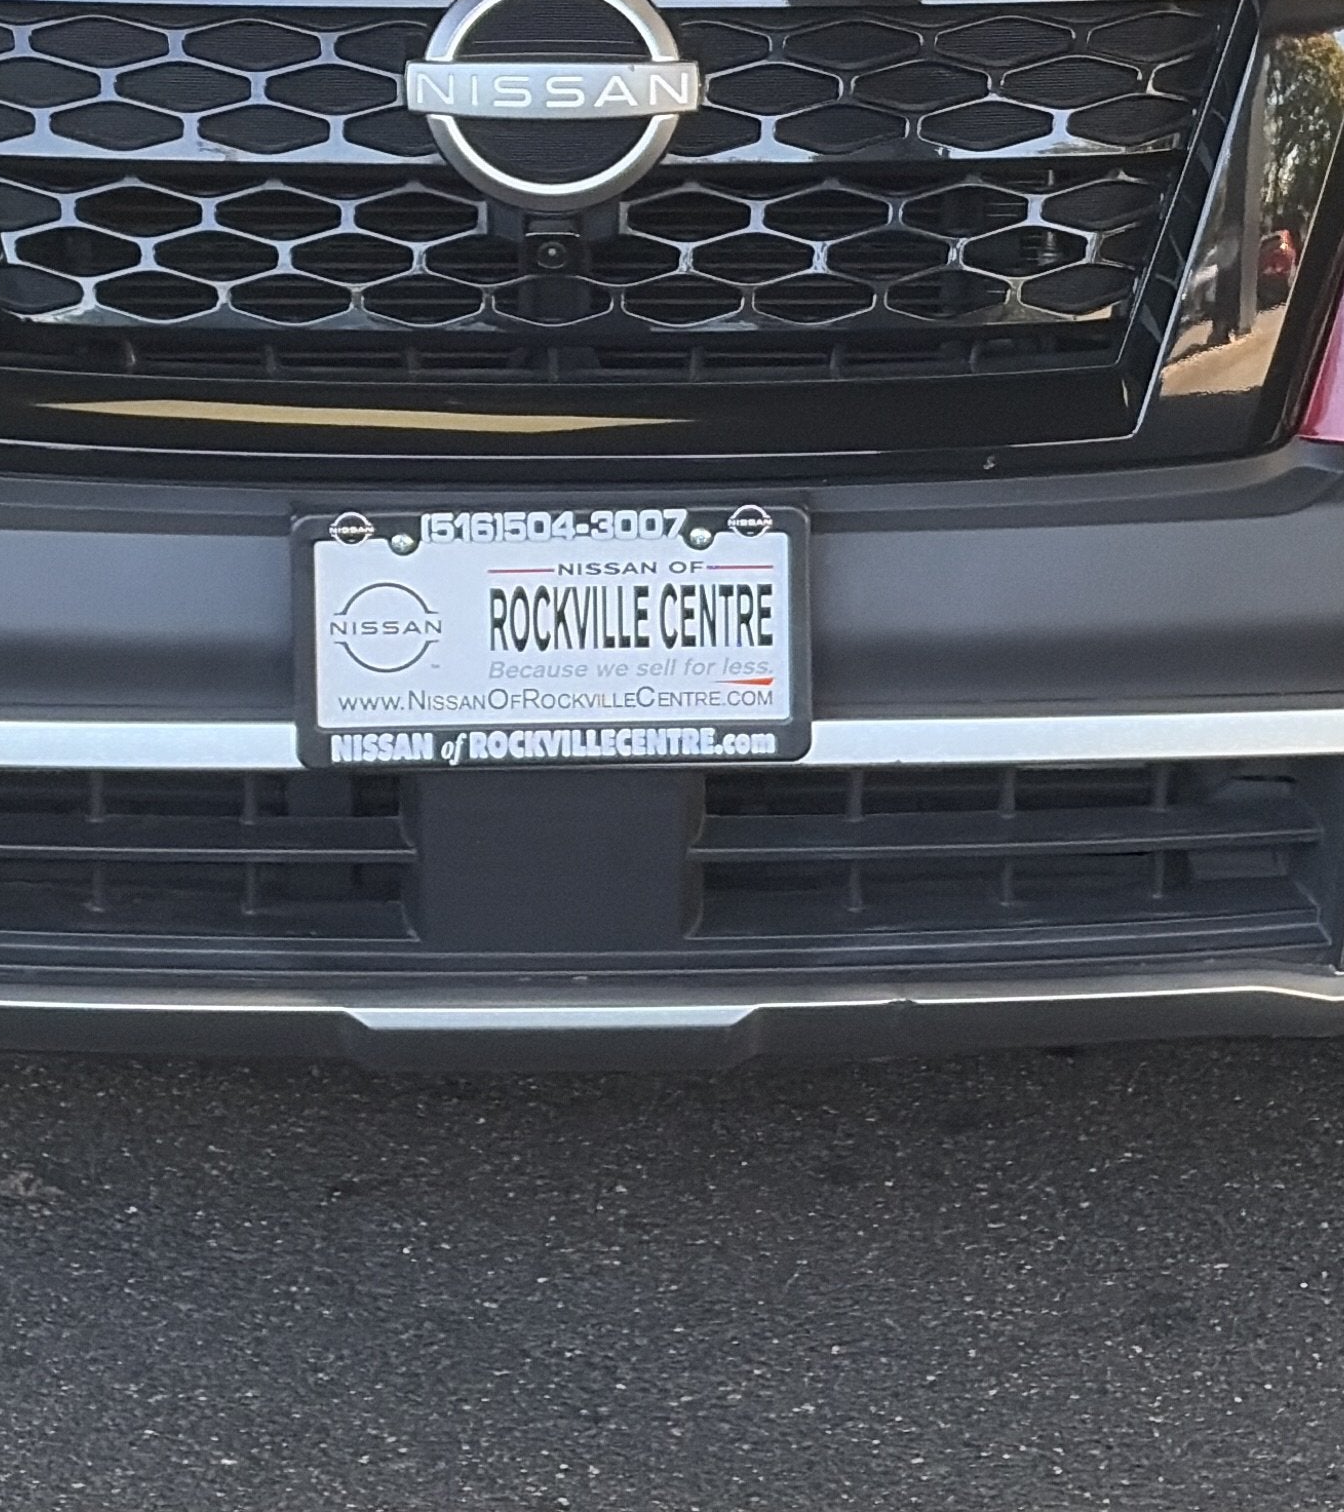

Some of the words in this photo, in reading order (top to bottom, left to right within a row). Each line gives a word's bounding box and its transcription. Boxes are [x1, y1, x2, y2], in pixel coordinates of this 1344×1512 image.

[416, 72, 689, 109] NISSAN
[420, 509, 688, 545] (516)504-3007
[558, 561, 658, 576] NISSAN
[669, 560, 705, 574] OF
[329, 619, 443, 636] NISSAN
[489, 584, 650, 653] ROCKVILLE
[659, 582, 774, 650] CENTRE
[488, 660, 588, 680] Because
[596, 664, 629, 678] we
[637, 658, 677, 677] sell
[684, 657, 717, 676] for
[722, 657, 774, 675] less.
[331, 732, 434, 763] NISSAN
[440, 733, 468, 766] of
[468, 727, 777, 760] ROCKVILLECENTRE.com
